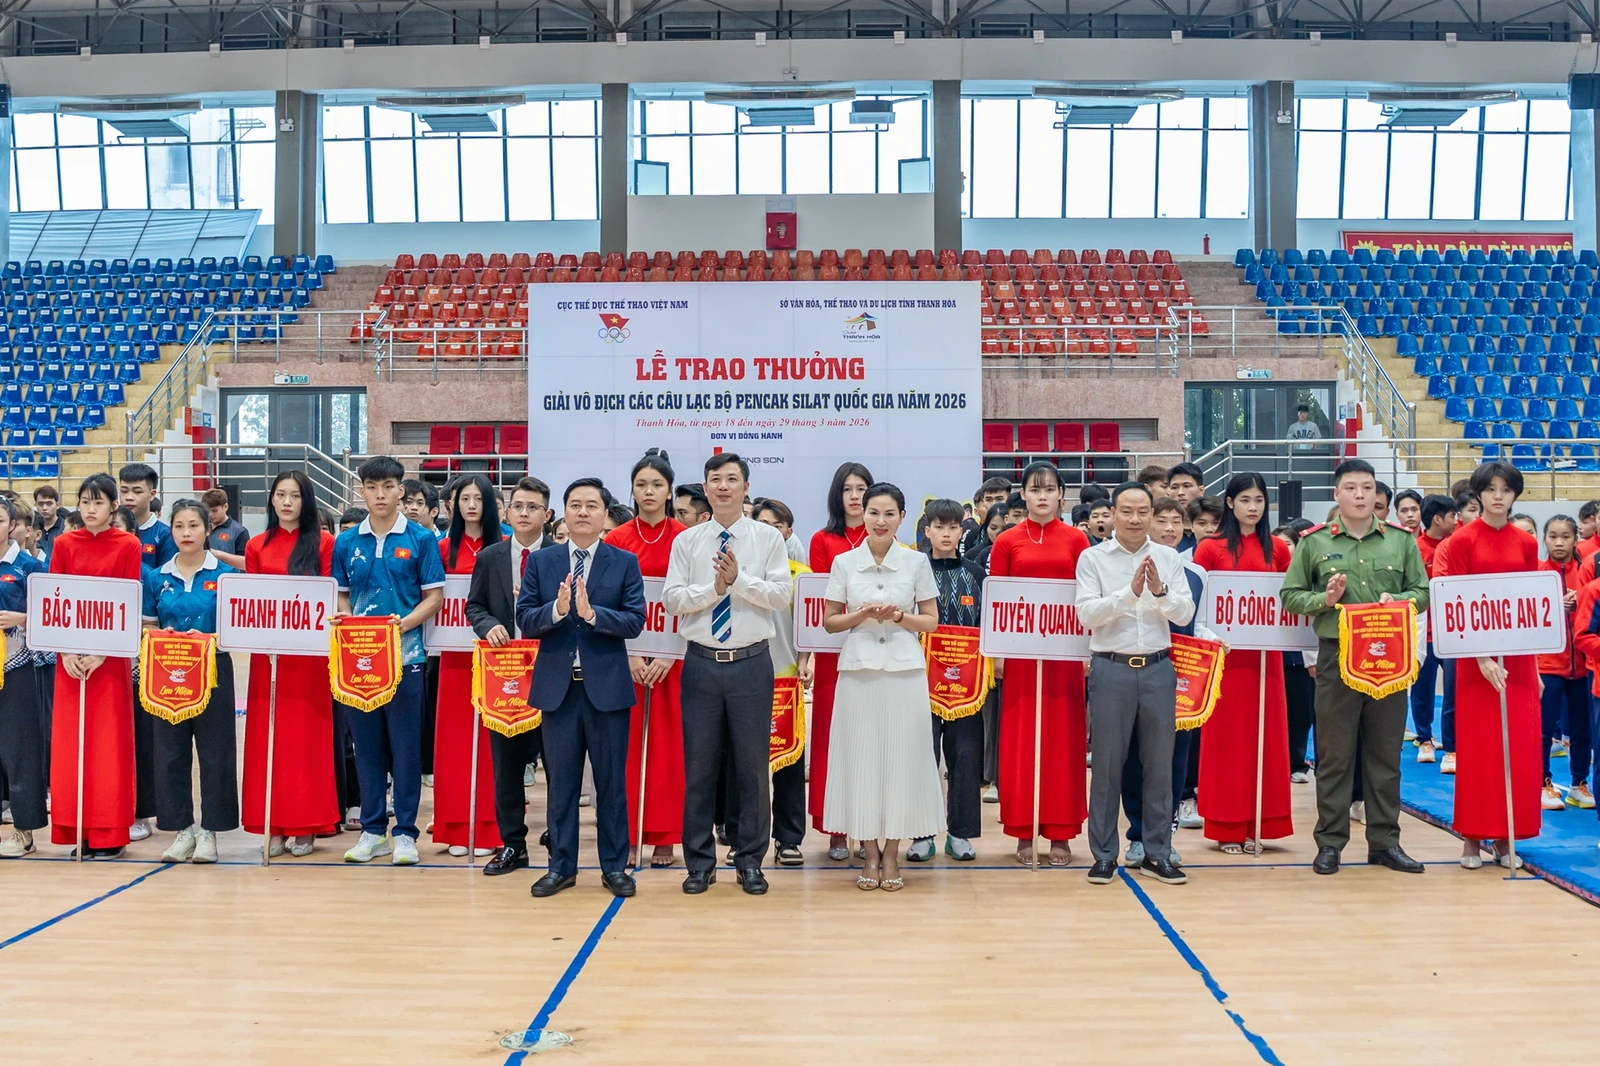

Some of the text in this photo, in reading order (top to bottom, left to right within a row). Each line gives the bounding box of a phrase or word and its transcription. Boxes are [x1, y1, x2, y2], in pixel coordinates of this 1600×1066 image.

[557, 301, 573, 311] CỤC
[592, 301, 608, 311] DỤC
[628, 301, 649, 309] THAO
[651, 299, 668, 311] VIỆT
[670, 301, 688, 309] NAM
[839, 300, 857, 308] THAO
[869, 300, 879, 308] DU
[881, 300, 897, 310] LỊCH
[917, 300, 940, 308] THANH
[636, 349, 865, 380] LỄ TRAO THƯỞNG
[543, 388, 966, 413] GIẢI VÔ ĐỊCH CÁC CÂU LẠC BỘ PENCAK SILAT QUỐC GIA NĂM 2026
[636, 419, 663, 427] Thanh
[666, 418, 687, 428] Hóa,
[701, 418, 722, 428] ngày
[725, 419, 735, 427] 18
[737, 416, 753, 427] đến
[755, 418, 776, 428] ngày
[779, 418, 790, 427] 29
[792, 418, 816, 428] tháng
[819, 418, 824, 426] 3
[827, 418, 846, 426] năm
[849, 418, 870, 426] 2026
[42, 587, 125, 631] BẮC NINH 1
[230, 593, 325, 631] THANH HÓA 2
[642, 601, 666, 632] NG
[804, 597, 828, 628] TUY
[992, 596, 1035, 633] TUYÊN
[1216, 589, 1234, 632] BỘ
[1238, 590, 1275, 626] CÔNG
[1445, 593, 1552, 639] BỘ CÔNG AN 2
